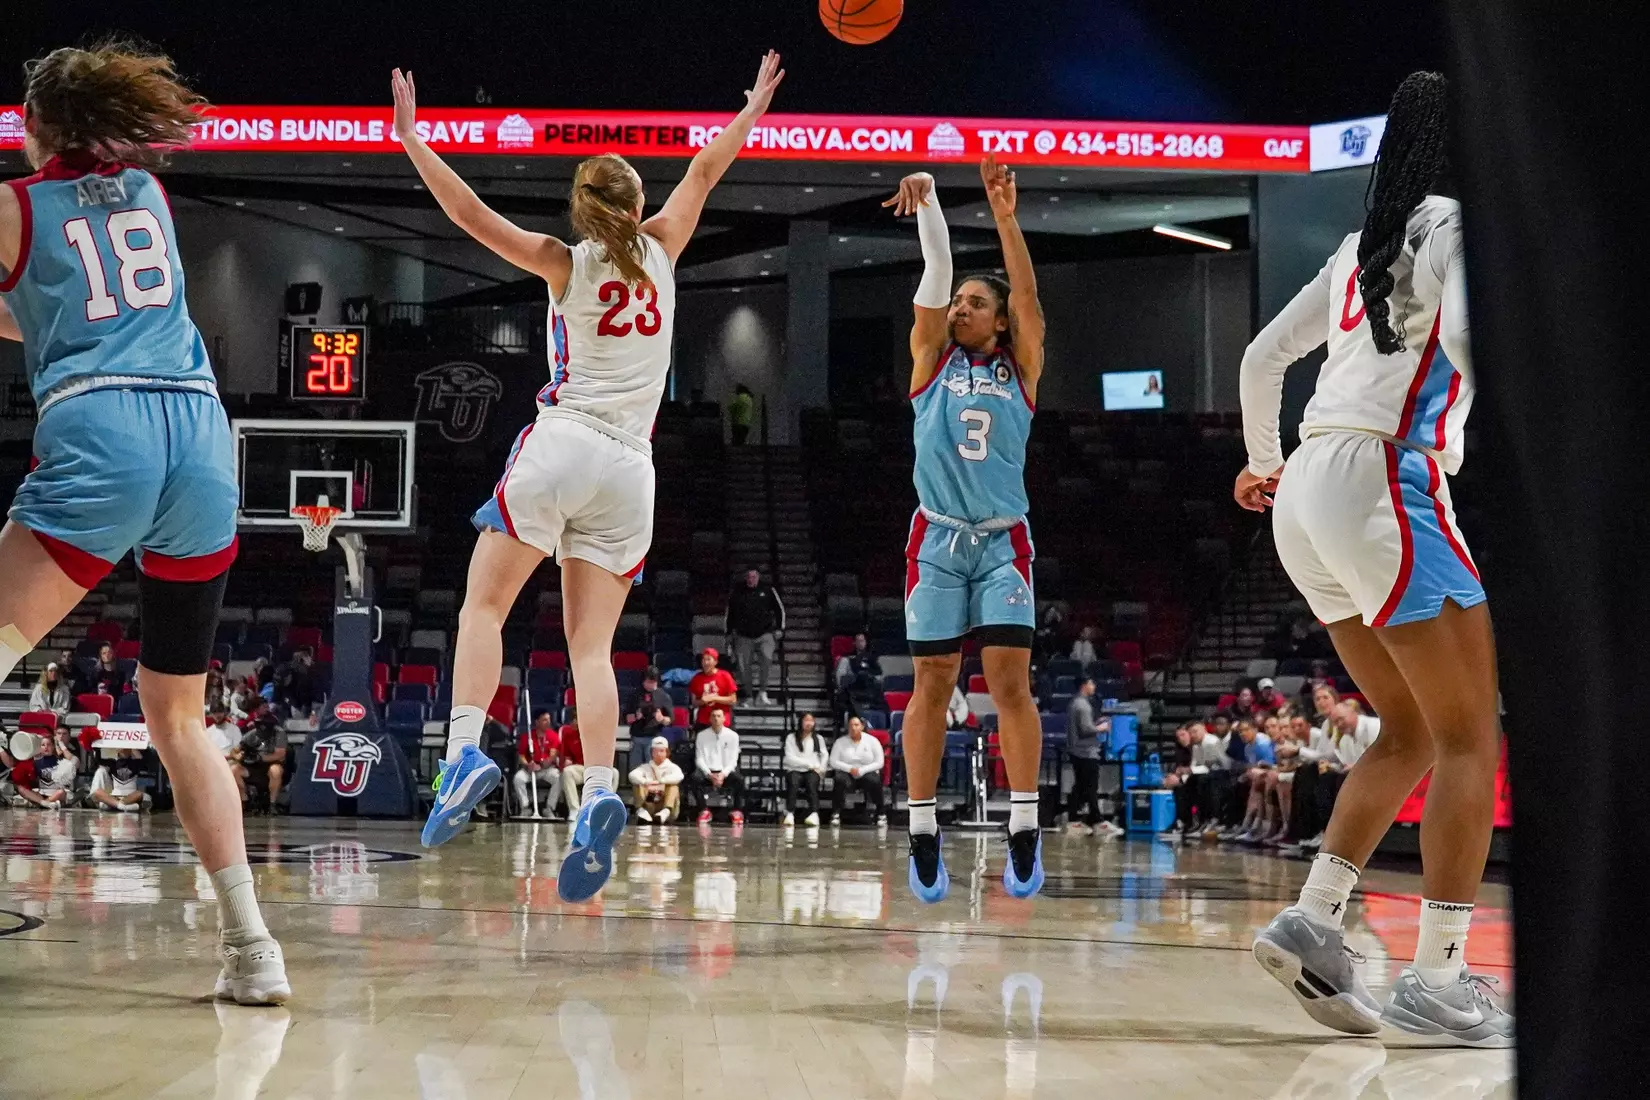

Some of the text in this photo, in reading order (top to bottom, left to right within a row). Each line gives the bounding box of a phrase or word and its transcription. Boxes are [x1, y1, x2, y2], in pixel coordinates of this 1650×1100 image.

[189, 117, 274, 141] TIONS
[280, 119, 384, 142] BUNDLE
[415, 120, 485, 144] SAVE
[977, 129, 1029, 153] TXT
[1033, 129, 1057, 155] @
[1061, 131, 1225, 159] 434-515-2868
[1263, 138, 1304, 159] GAF
[62, 207, 174, 322] 18
[597, 280, 662, 337] 23
[313, 333, 359, 356] 9:32
[307, 354, 351, 392] 20
[957, 407, 992, 462] 3
